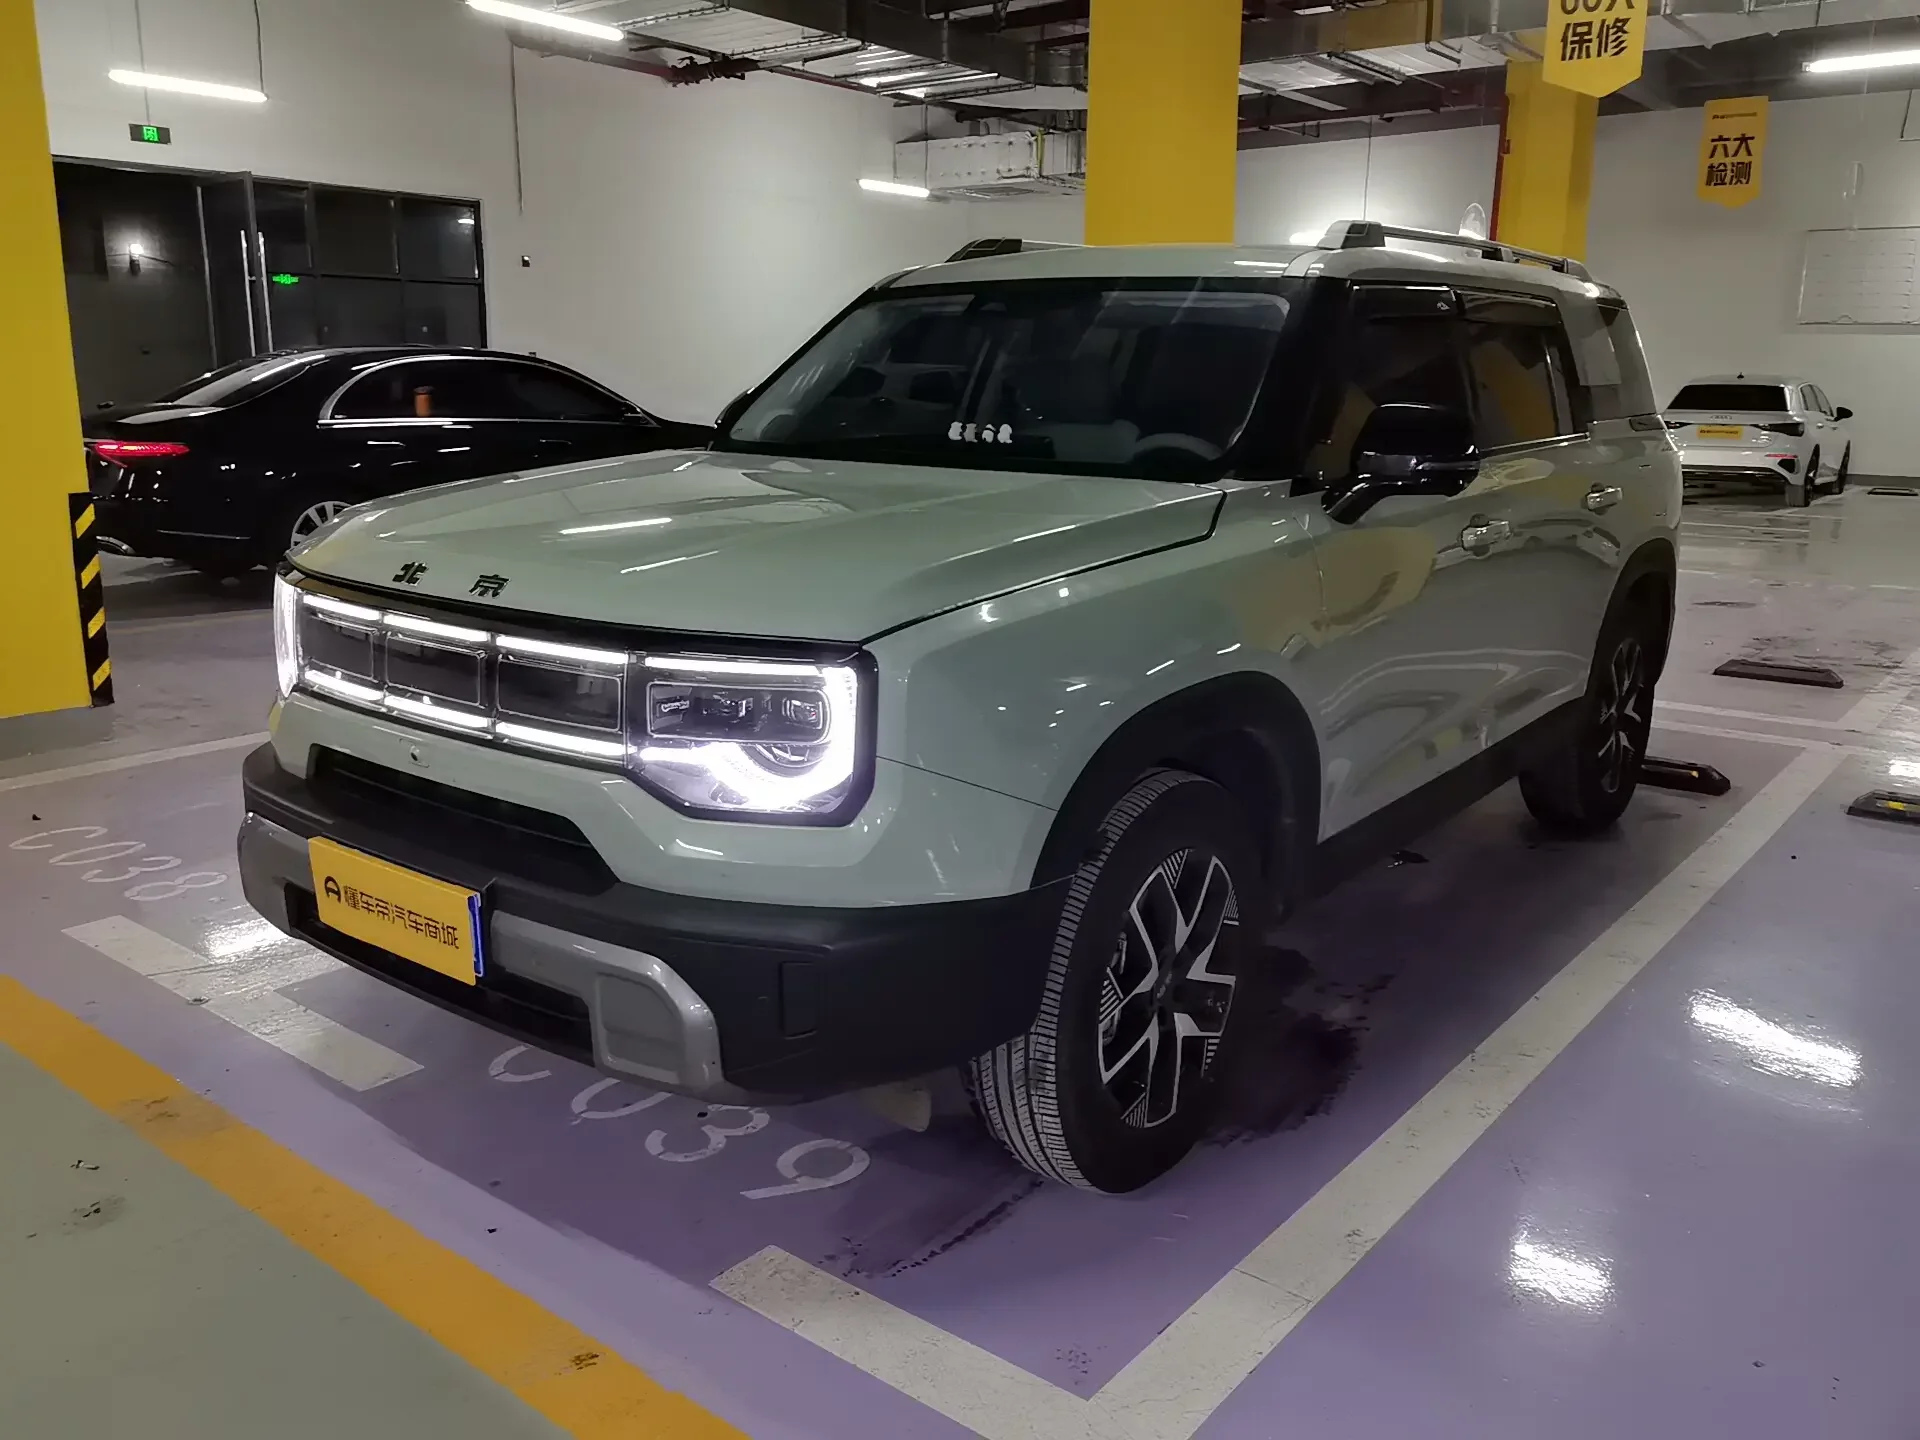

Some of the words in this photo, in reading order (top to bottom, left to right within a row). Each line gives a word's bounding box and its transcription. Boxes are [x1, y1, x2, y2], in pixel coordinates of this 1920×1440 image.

[1560, 17, 1632, 61] 保修
[1709, 133, 1755, 159] 六大
[1705, 161, 1753, 187] 检测
[392, 561, 511, 598] 北京
[8, 825, 228, 901] C038
[344, 885, 460, 950] 懂车帝汽车商城
